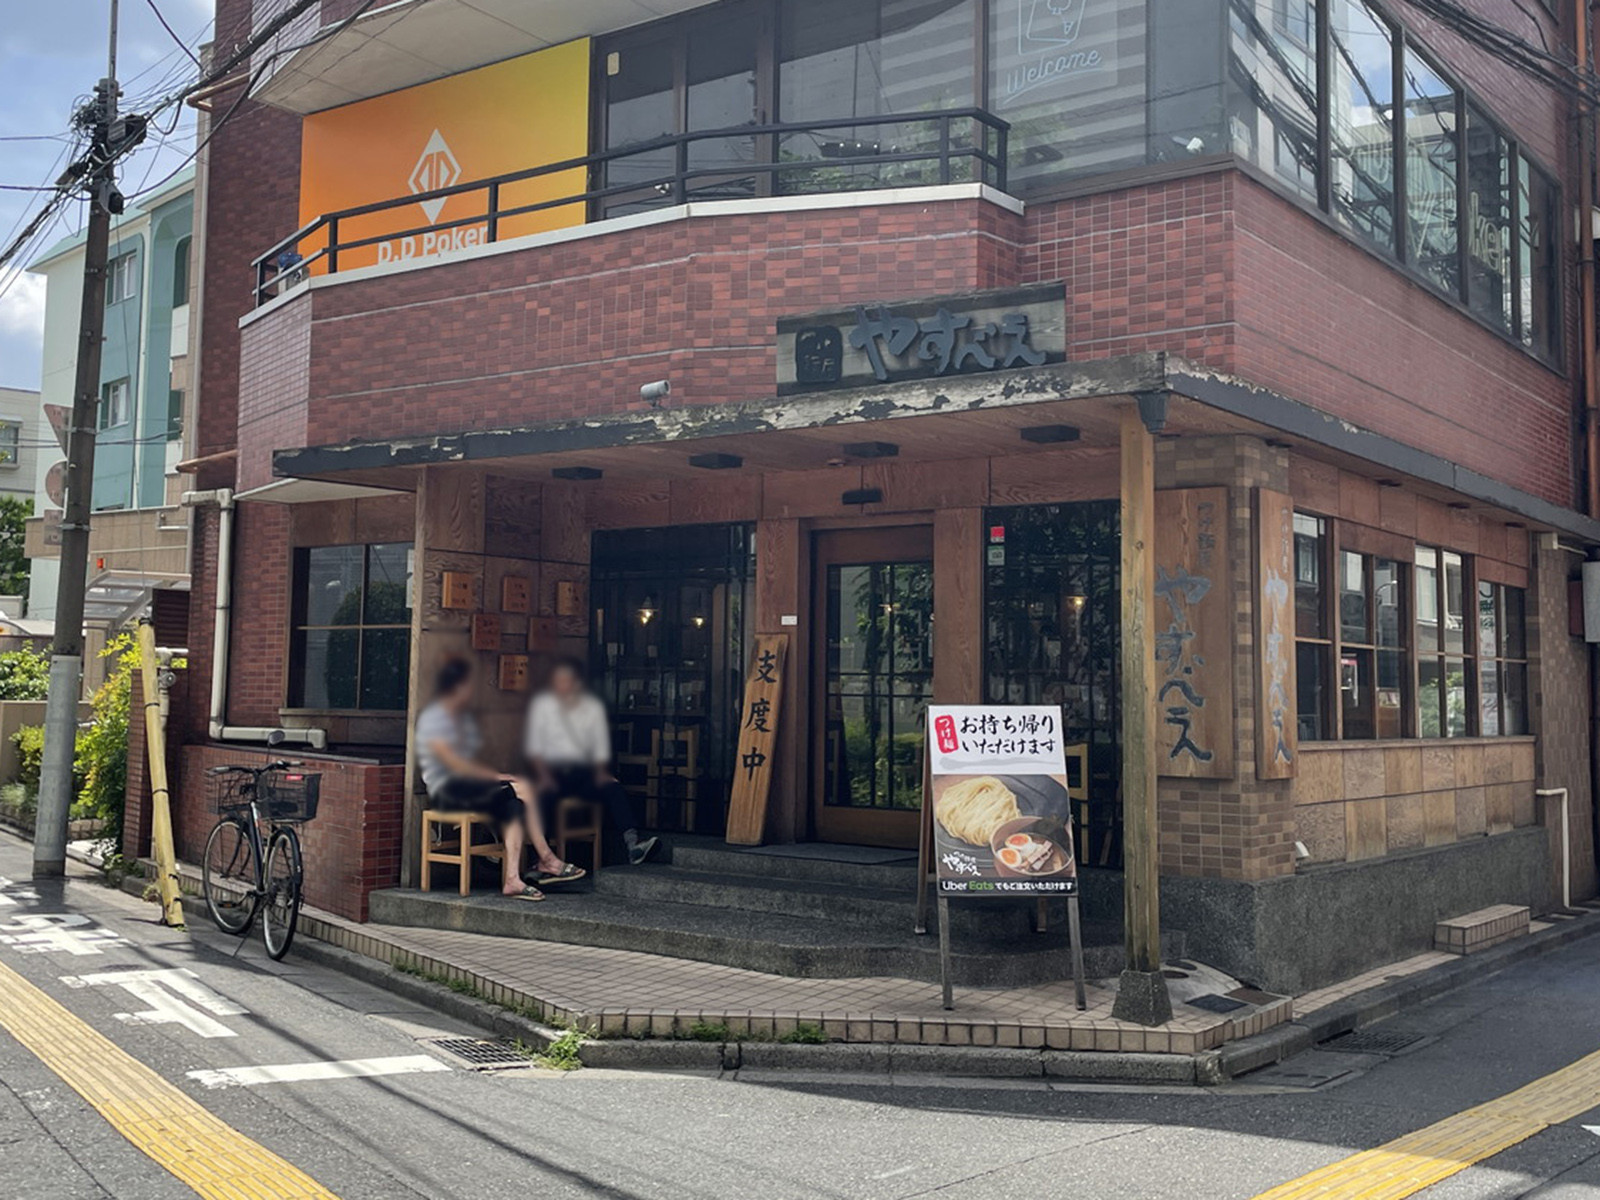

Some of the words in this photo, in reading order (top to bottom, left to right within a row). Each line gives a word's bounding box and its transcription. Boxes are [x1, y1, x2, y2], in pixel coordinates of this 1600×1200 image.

[1006, 49, 1102, 94] Welcome
[377, 236, 416, 265] D.D
[422, 226, 489, 257] Poker
[848, 304, 1047, 380] やすべえ
[742, 649, 778, 782] 支度中
[960, 714, 1055, 736] お持ち帰り
[938, 718, 956, 750] つけ麺
[961, 738, 1057, 755] いただけます
[941, 881, 968, 891] Uber
[968, 880, 995, 890] Eats
